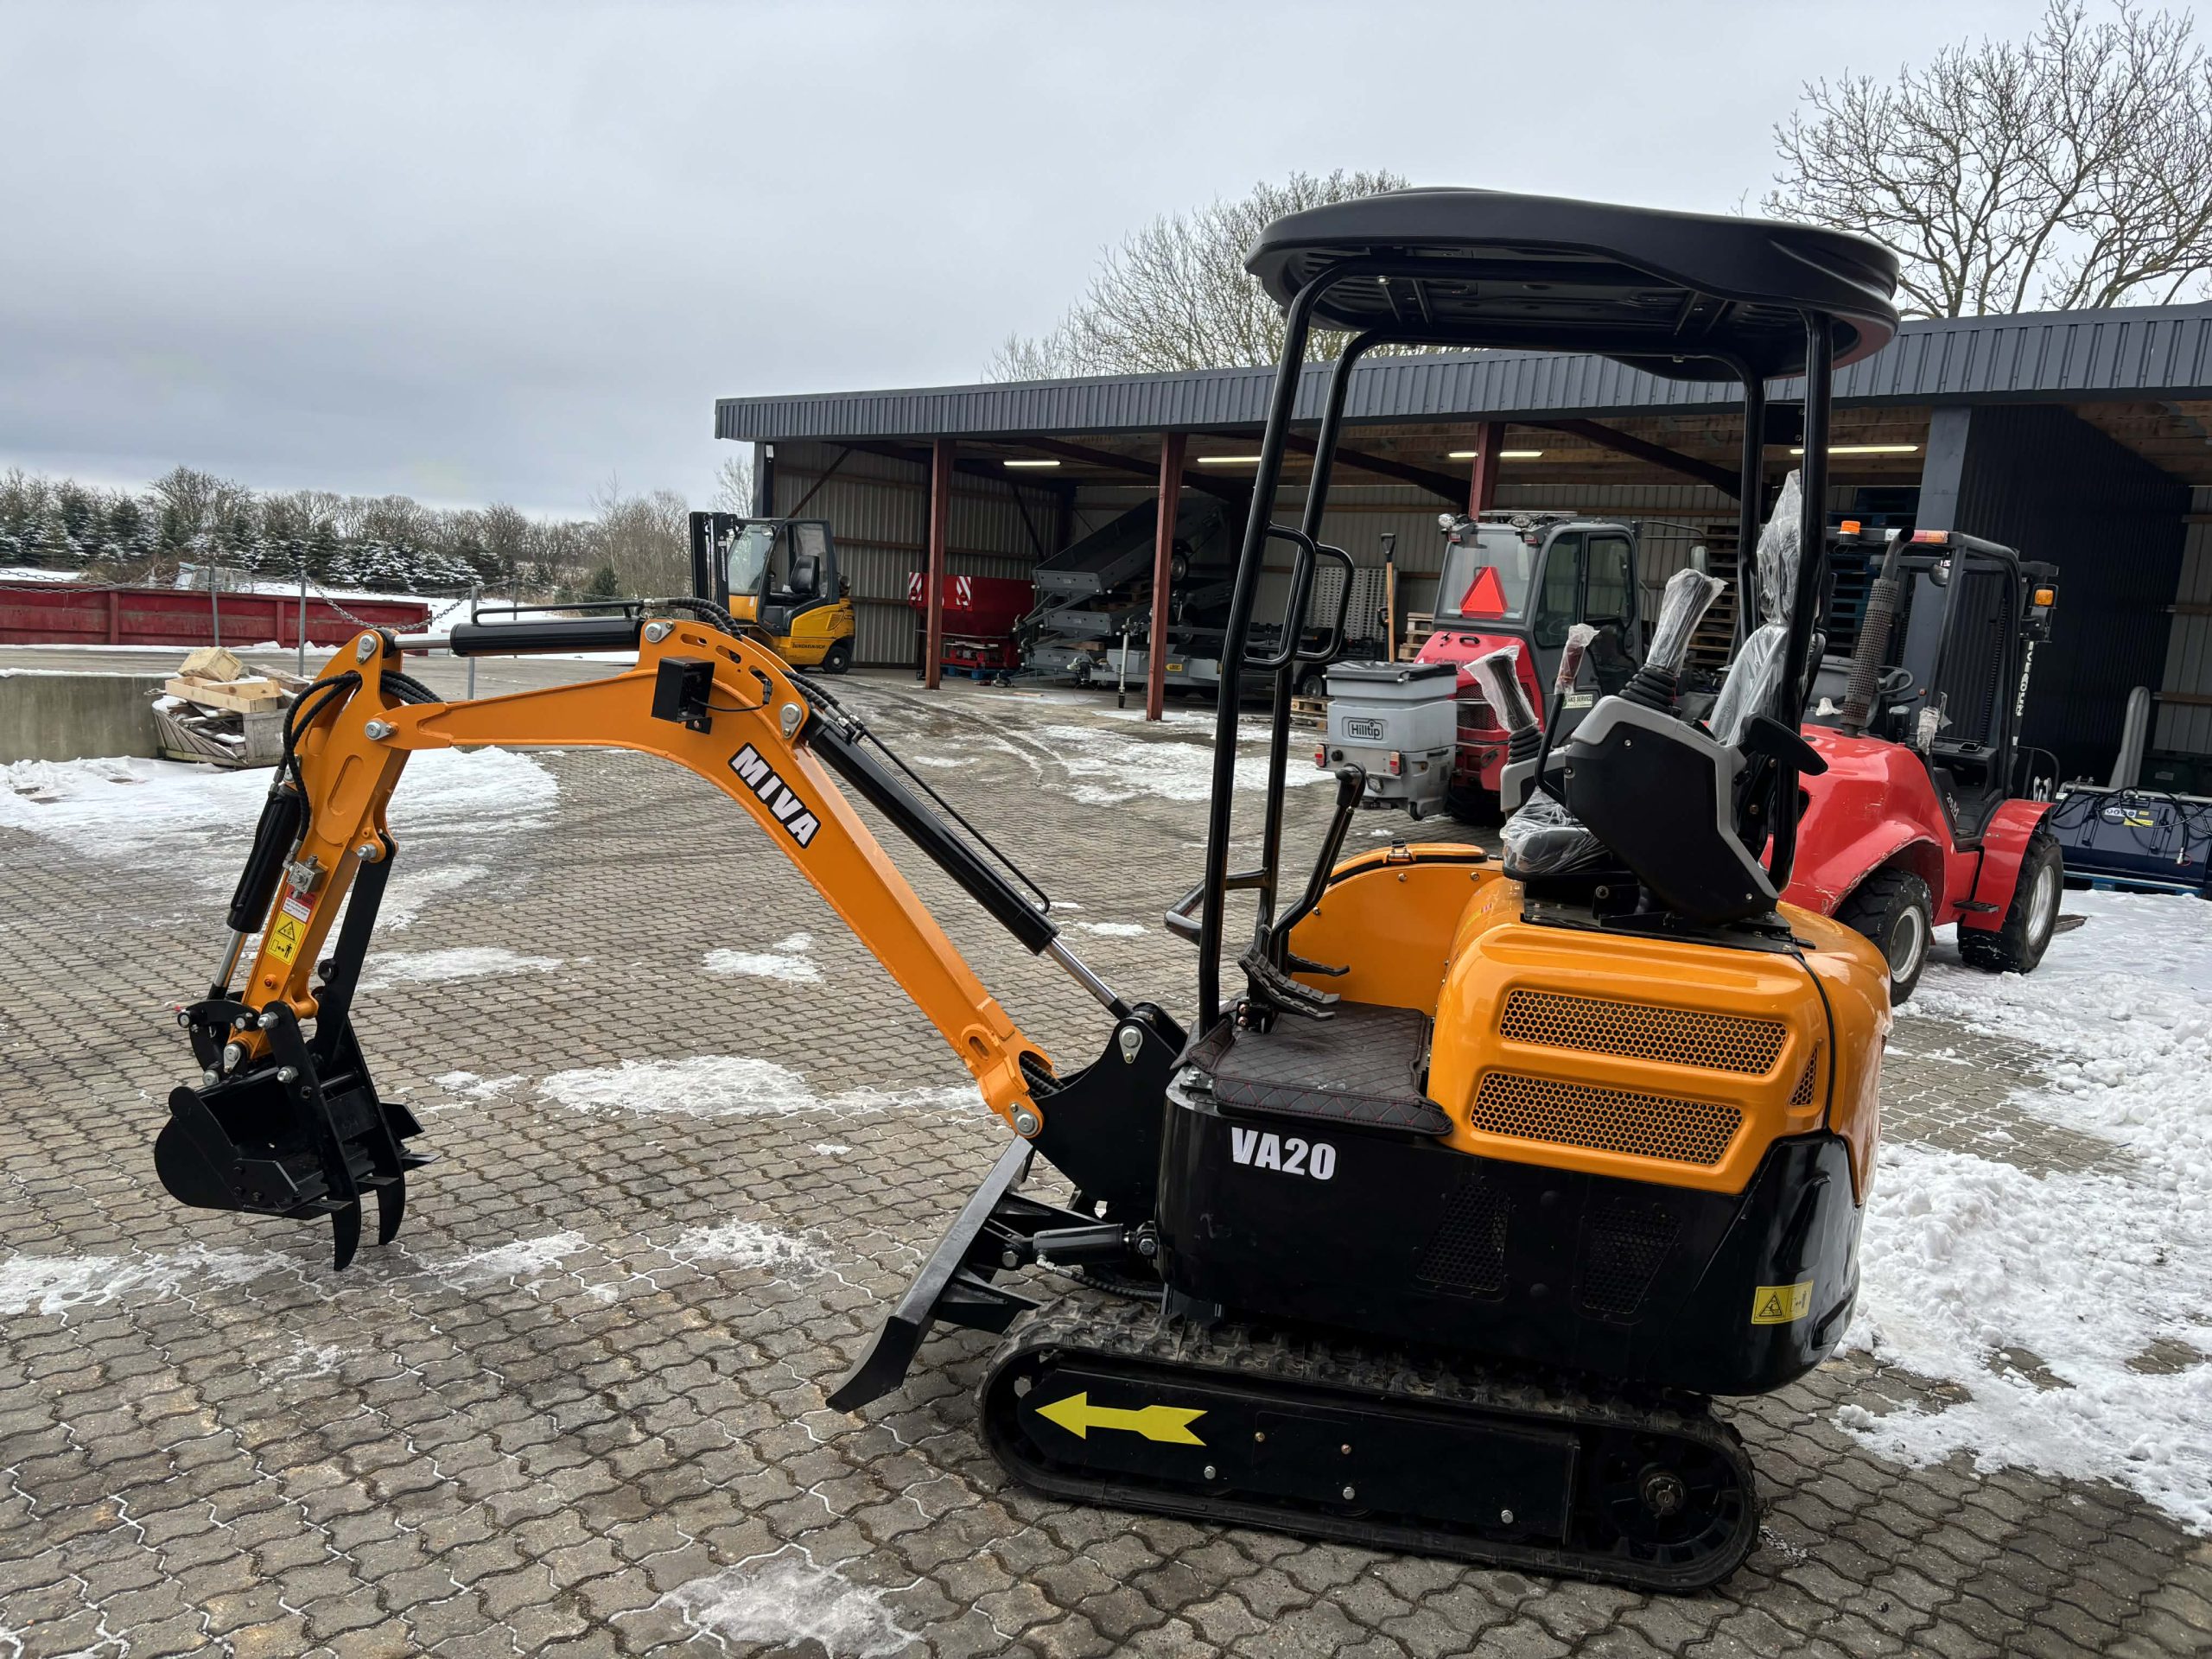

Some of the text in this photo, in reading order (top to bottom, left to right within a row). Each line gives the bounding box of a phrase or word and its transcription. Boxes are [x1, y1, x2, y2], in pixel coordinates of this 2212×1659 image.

[1351, 722, 1381, 740] Hilltip
[730, 745, 819, 846] MIVA
[1230, 1126, 1337, 1180] VA20
